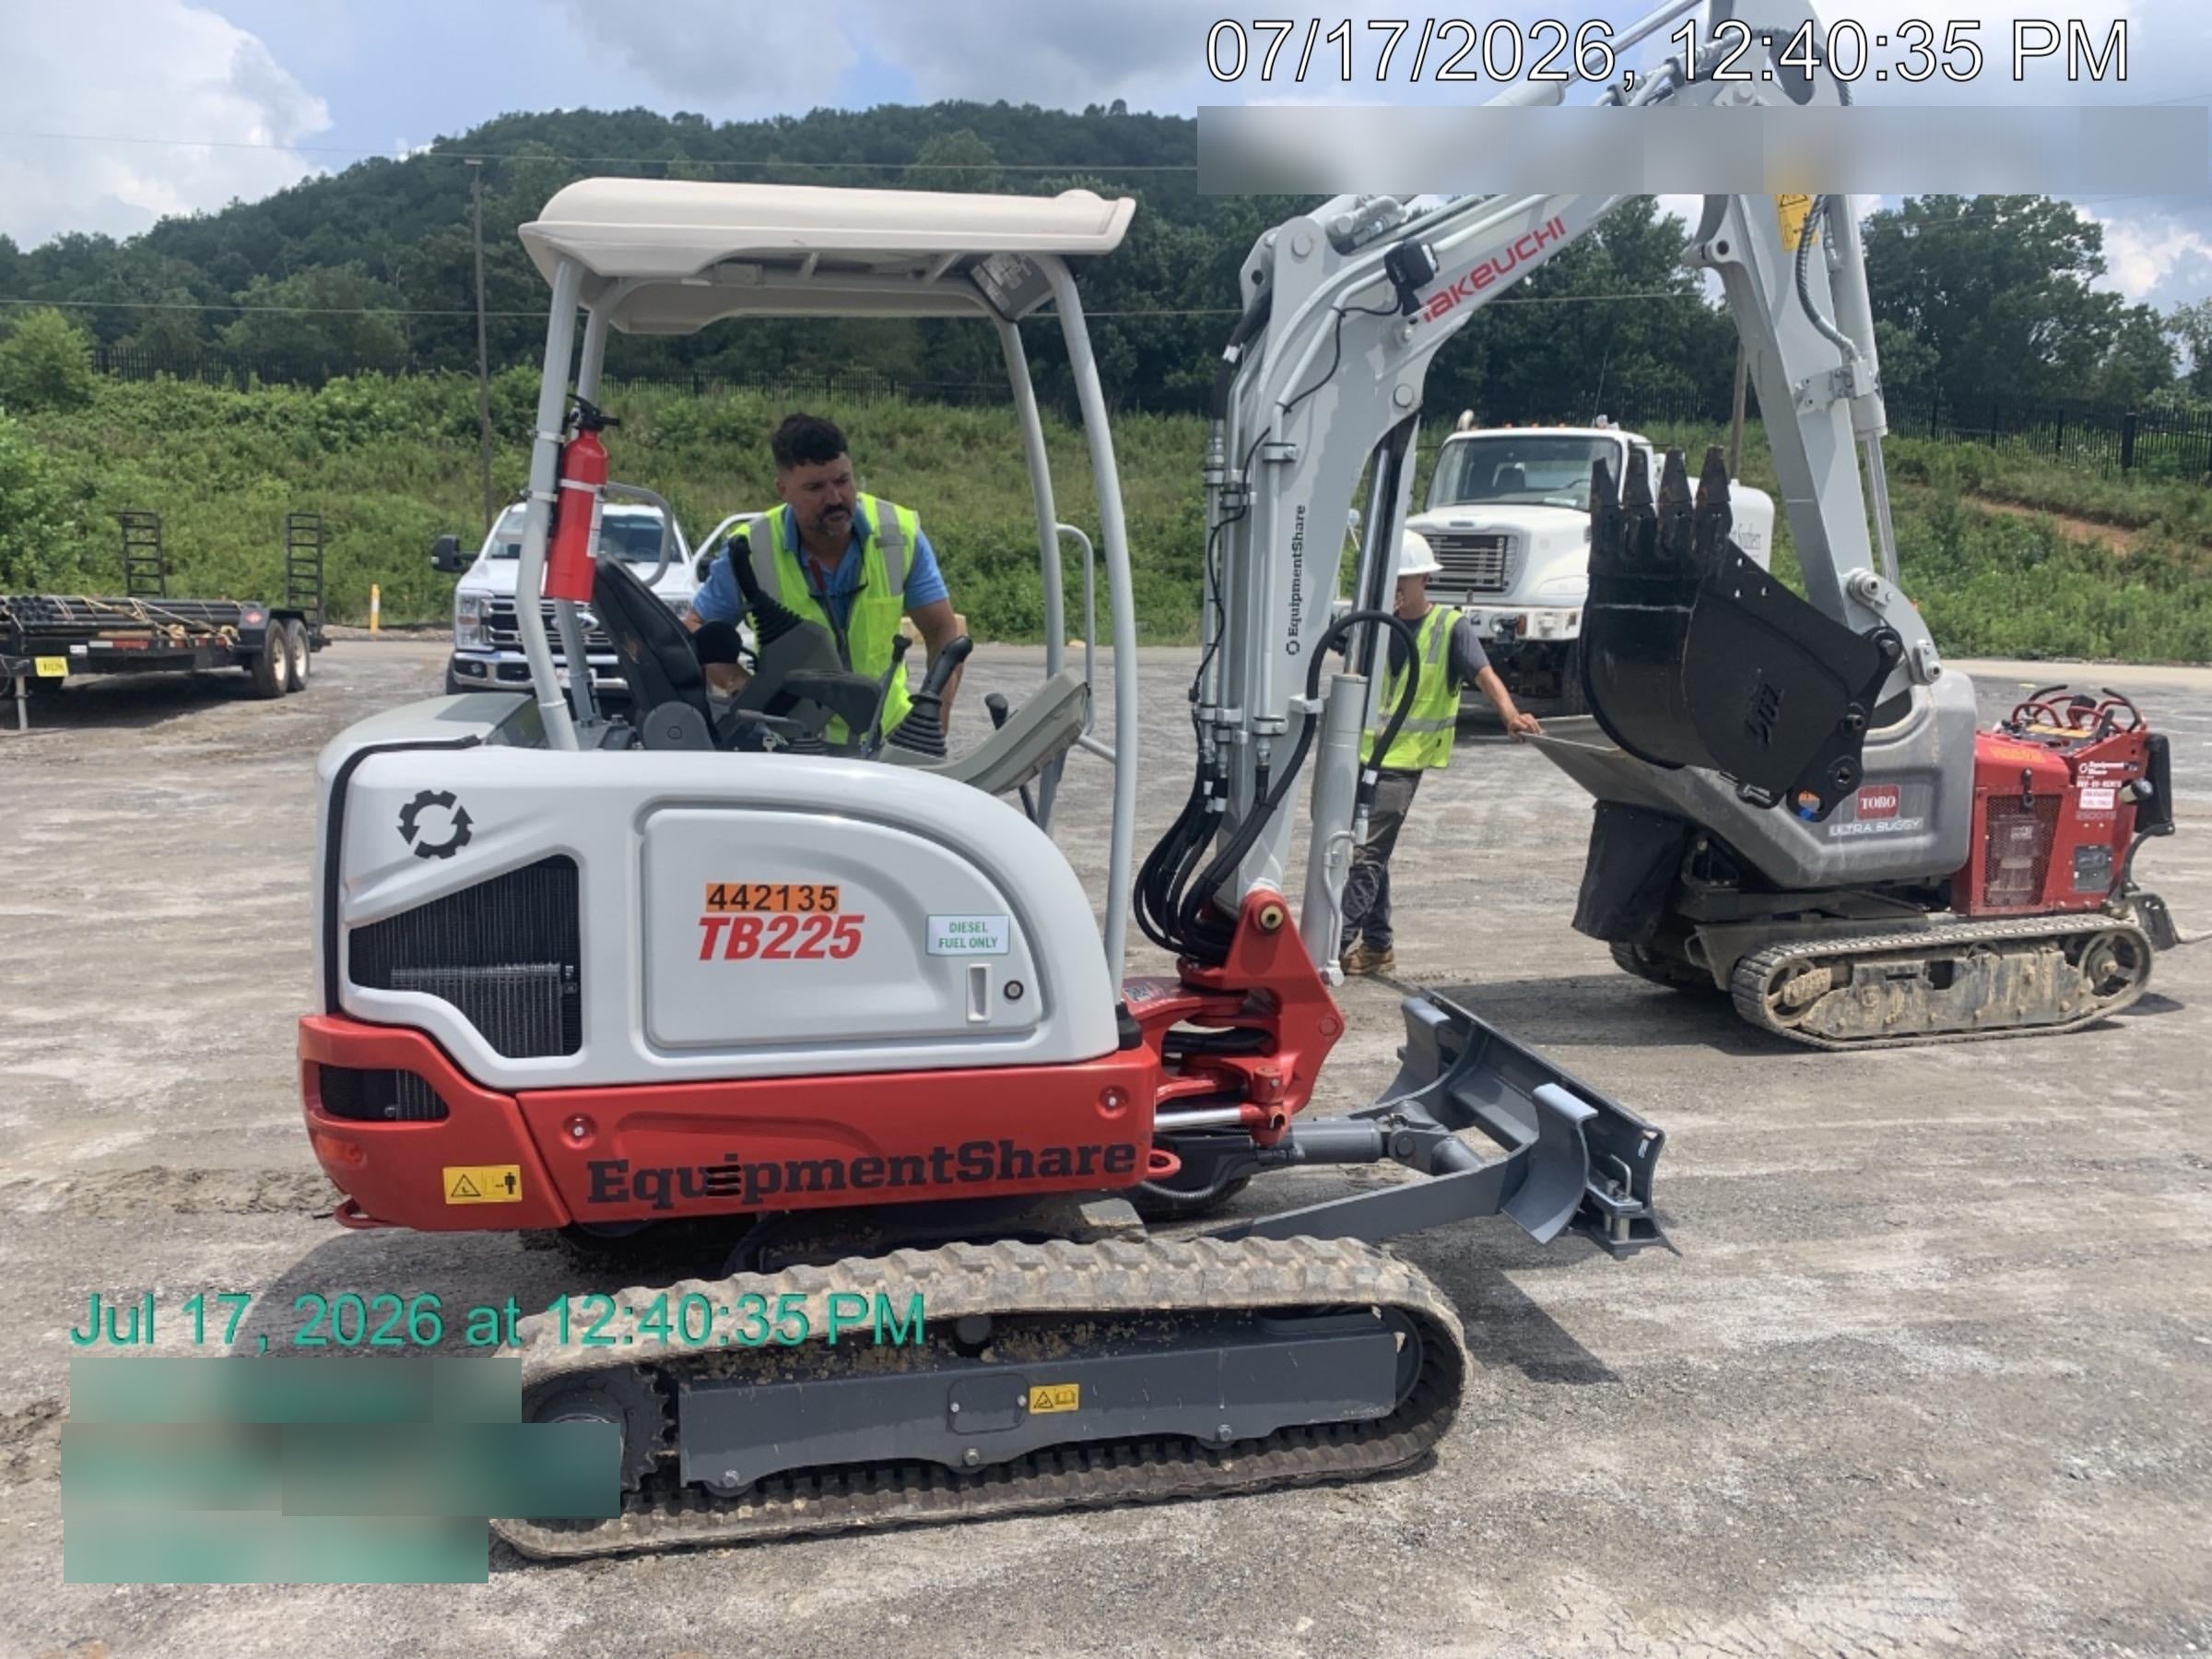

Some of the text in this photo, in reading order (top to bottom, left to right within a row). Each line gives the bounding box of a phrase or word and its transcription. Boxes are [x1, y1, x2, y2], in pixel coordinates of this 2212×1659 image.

[1288, 504, 1306, 638] EquipmentShare
[1860, 795, 1897, 810] TORO
[1830, 818, 1922, 836] ULTRA BUGGY
[707, 884, 838, 912] 442135
[699, 914, 865, 960] TB225
[948, 922, 988, 934] DIESEL
[938, 936, 998, 948] FUEL ONLY
[586, 1140, 1136, 1210] EquipmentShare
